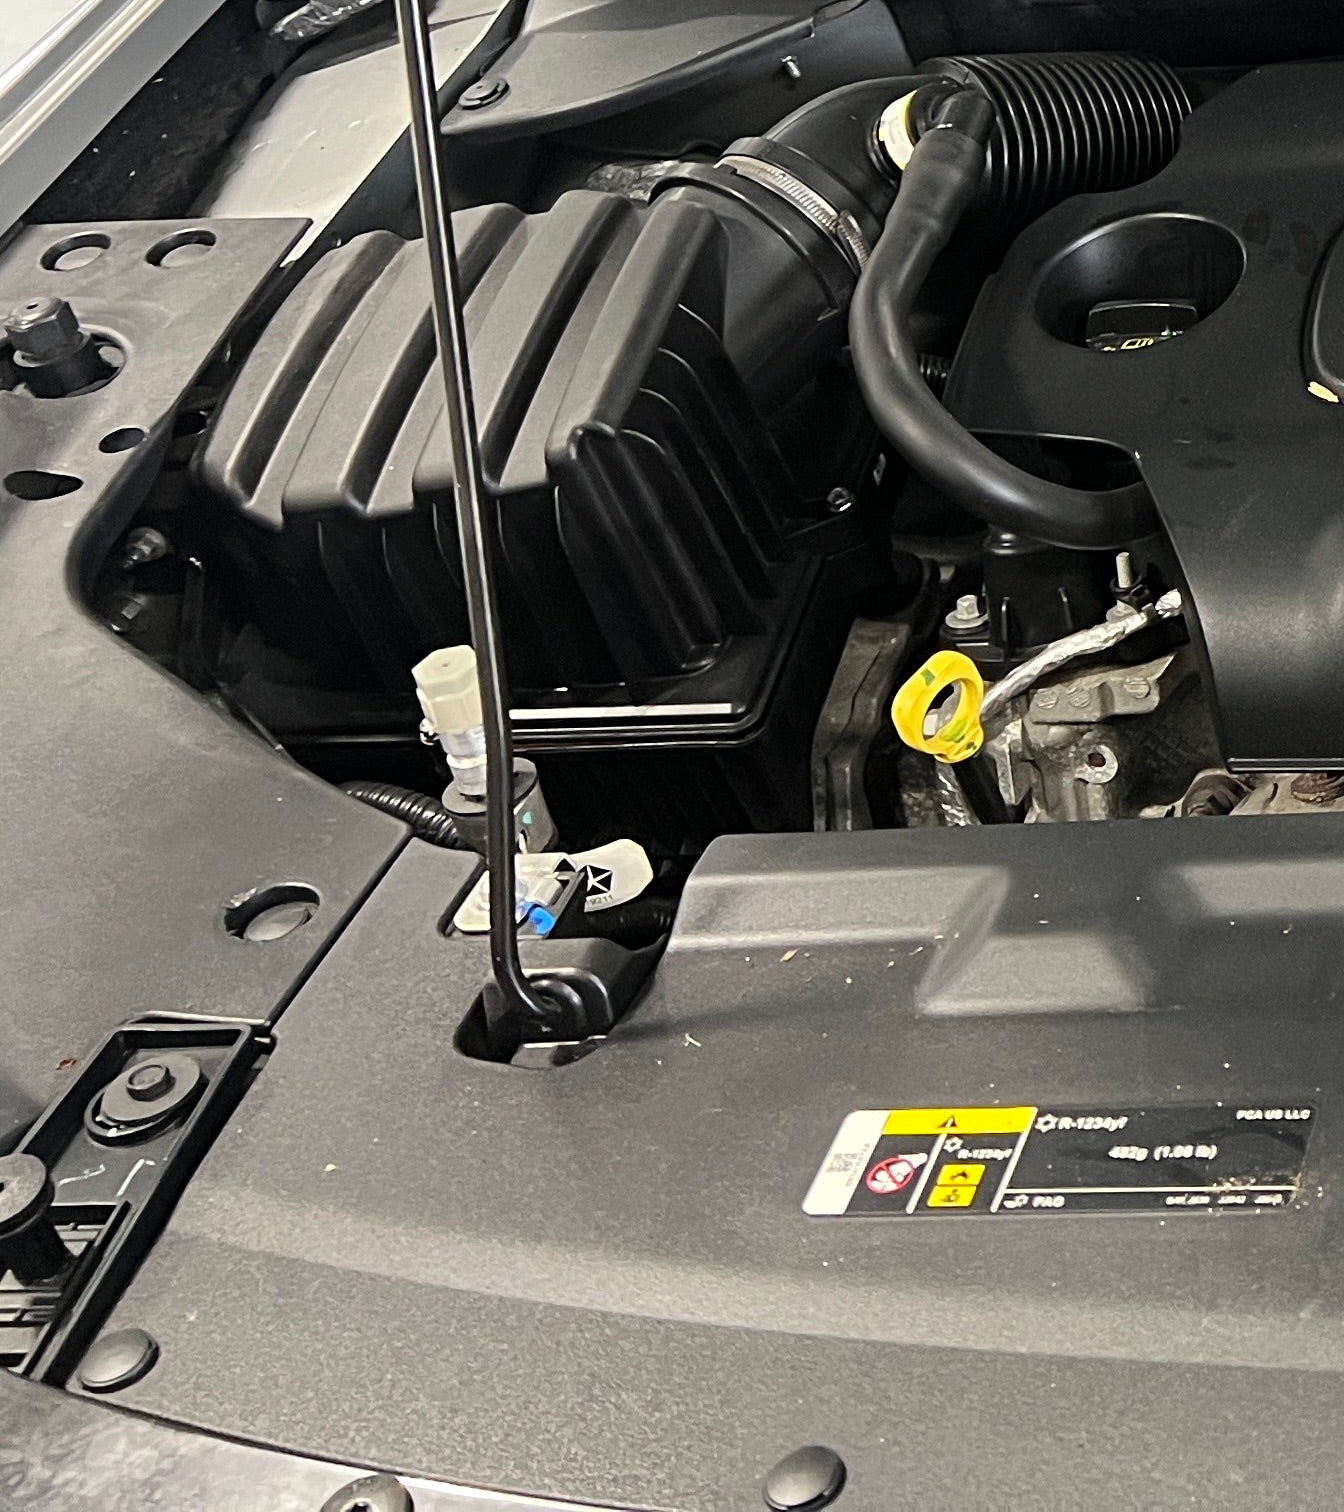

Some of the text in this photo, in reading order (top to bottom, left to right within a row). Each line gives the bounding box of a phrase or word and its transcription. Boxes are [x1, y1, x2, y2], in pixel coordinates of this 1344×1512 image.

[1236, 1108, 1311, 1121] FCA US LLC
[1058, 1115, 1129, 1132] R-1234yf
